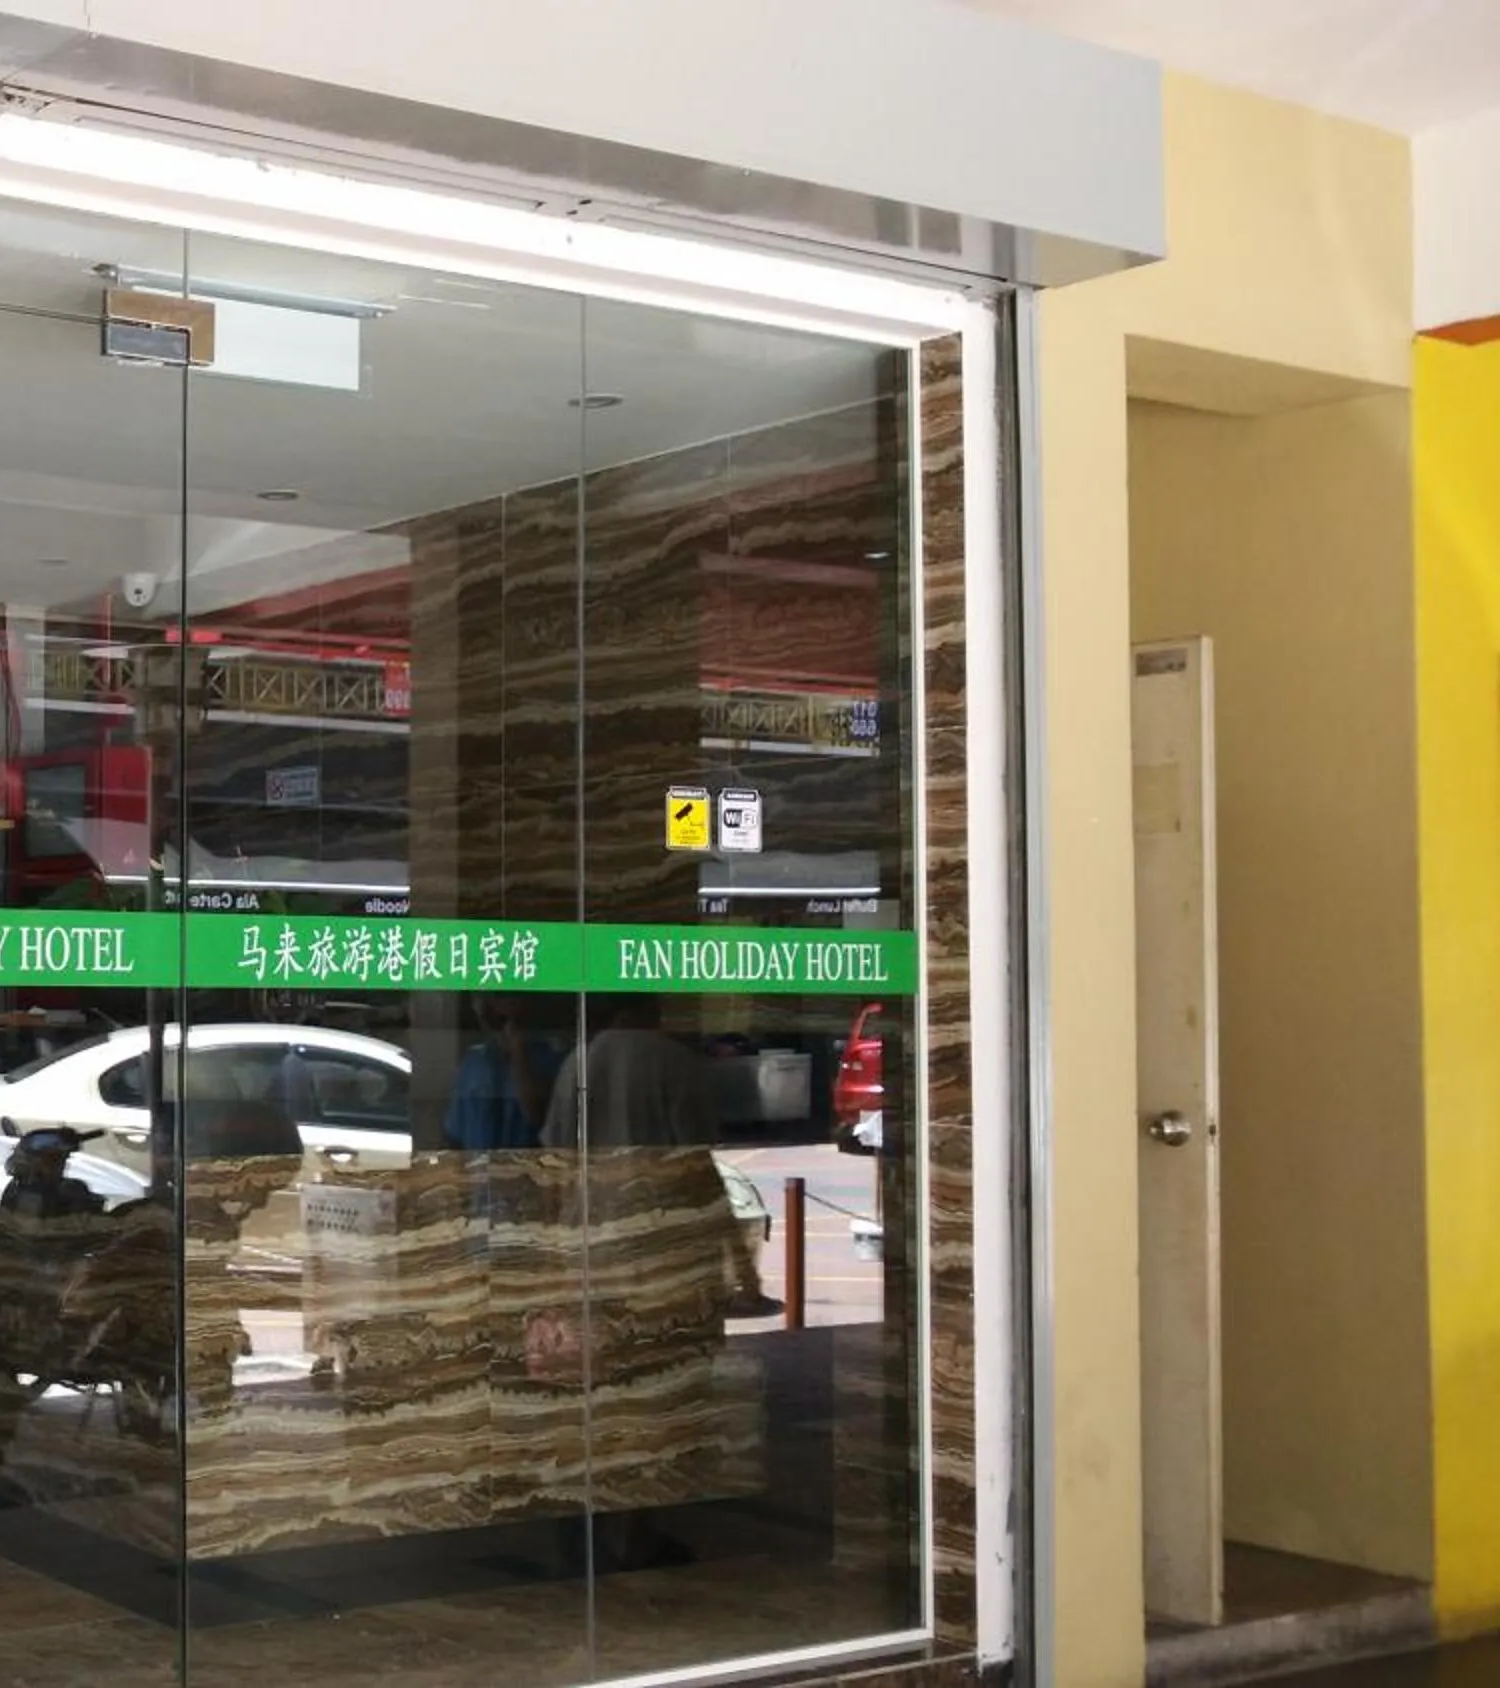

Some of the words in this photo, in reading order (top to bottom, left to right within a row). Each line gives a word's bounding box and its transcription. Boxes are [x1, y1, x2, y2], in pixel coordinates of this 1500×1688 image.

[19, 927, 134, 972] HOTEL
[237, 923, 540, 983] 马来旅游港假日宾馆
[620, 938, 673, 980] FAN
[680, 940, 799, 980] HOLIDAY
[806, 943, 888, 981] HOTEL
